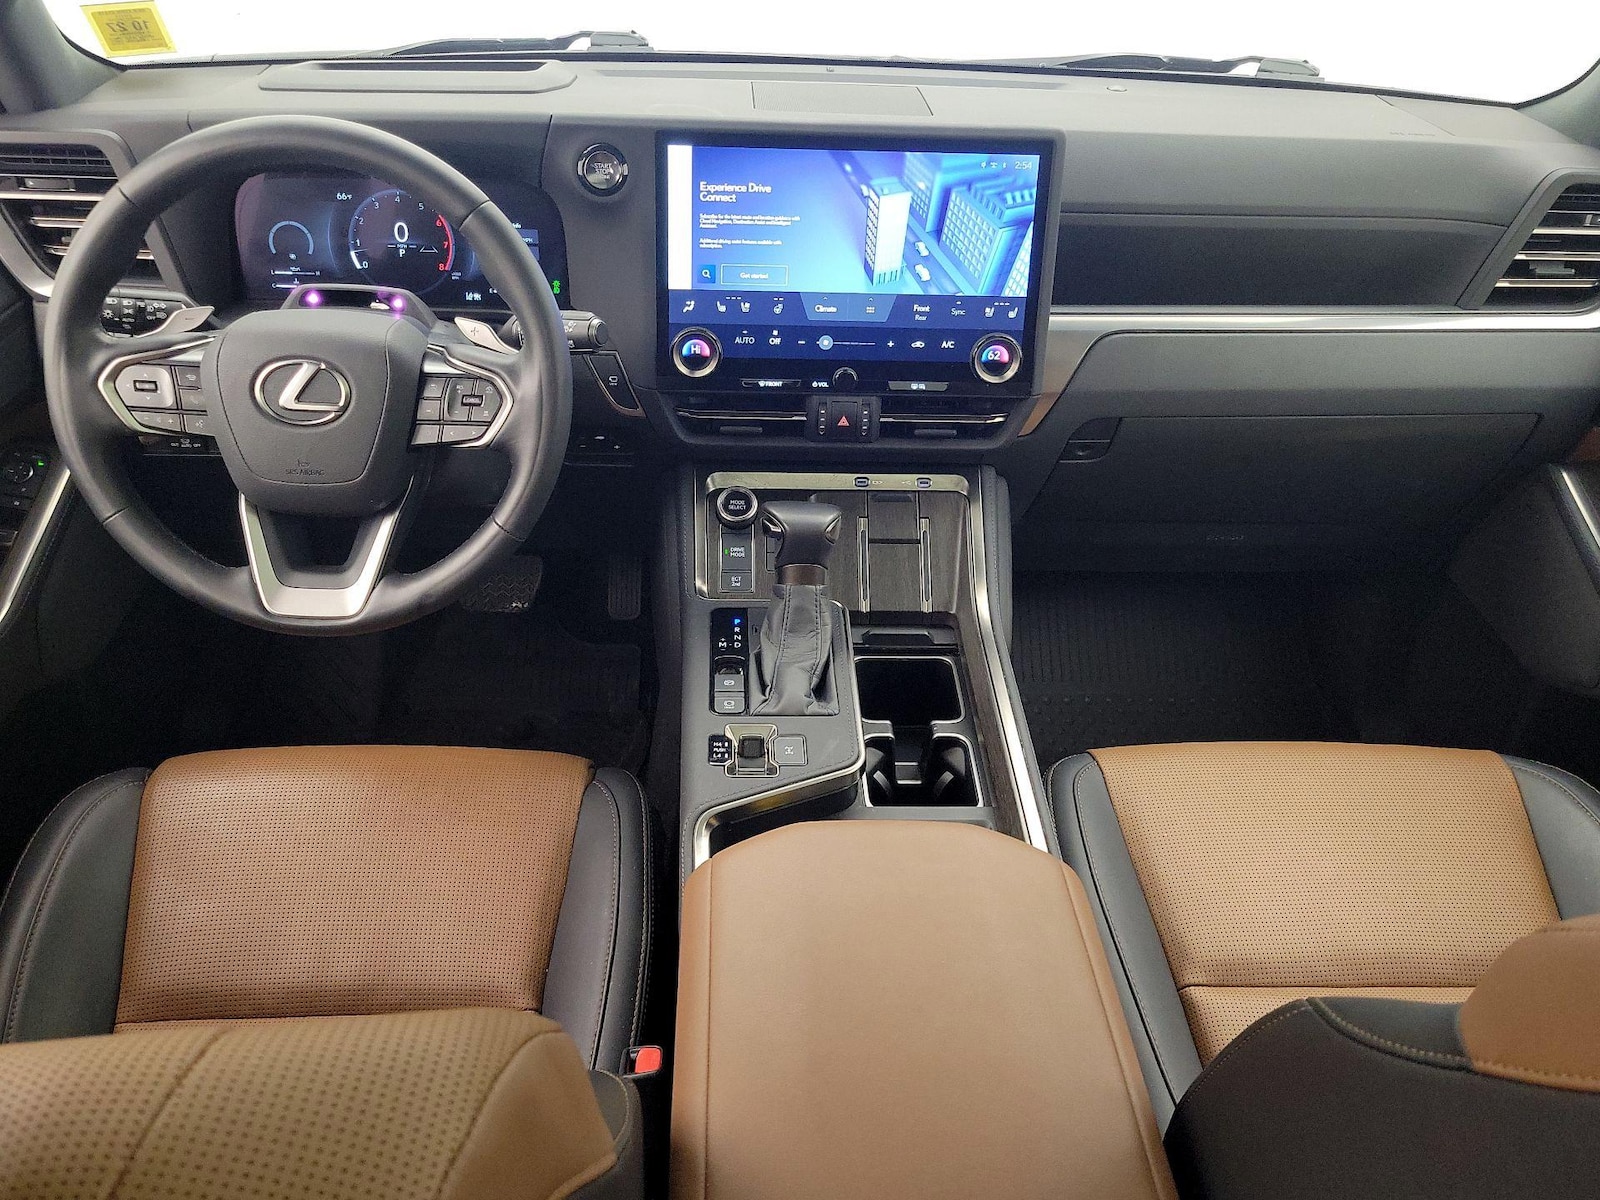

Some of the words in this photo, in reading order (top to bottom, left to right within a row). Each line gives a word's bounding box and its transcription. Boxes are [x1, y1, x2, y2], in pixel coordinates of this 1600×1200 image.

[1015, 161, 1032, 170] 2:54
[700, 181, 747, 193] Experience
[748, 183, 772, 193] Drive
[700, 192, 737, 202] Connect
[359, 217, 364, 225] 2
[436, 219, 442, 227] 6
[394, 222, 409, 243] 0
[399, 249, 406, 258] P
[363, 261, 369, 269] 0
[814, 304, 838, 313] Climate
[913, 304, 930, 313] Front
[951, 308, 966, 316] Sync
[691, 344, 701, 354] Hi
[941, 340, 955, 349] A/C
[987, 350, 1001, 361] 62
